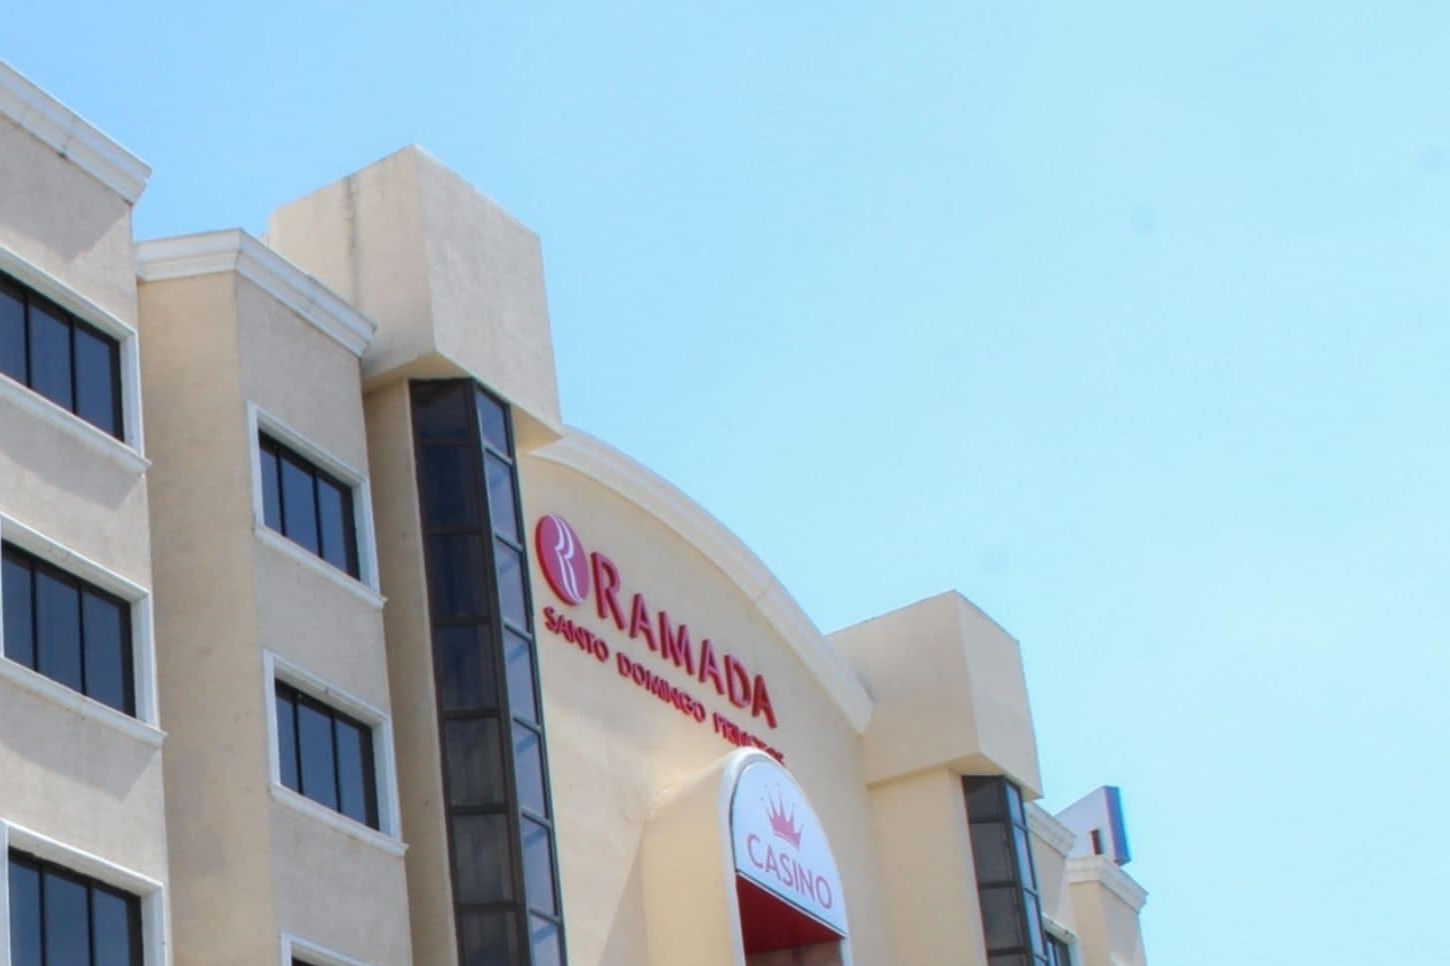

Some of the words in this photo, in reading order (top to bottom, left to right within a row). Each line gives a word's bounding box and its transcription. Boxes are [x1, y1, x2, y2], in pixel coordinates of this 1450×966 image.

[543, 605, 609, 663] SANTO
[616, 652, 706, 722] DOMINGO
[590, 552, 777, 729] RAMADA
[746, 832, 833, 909] CASINO
